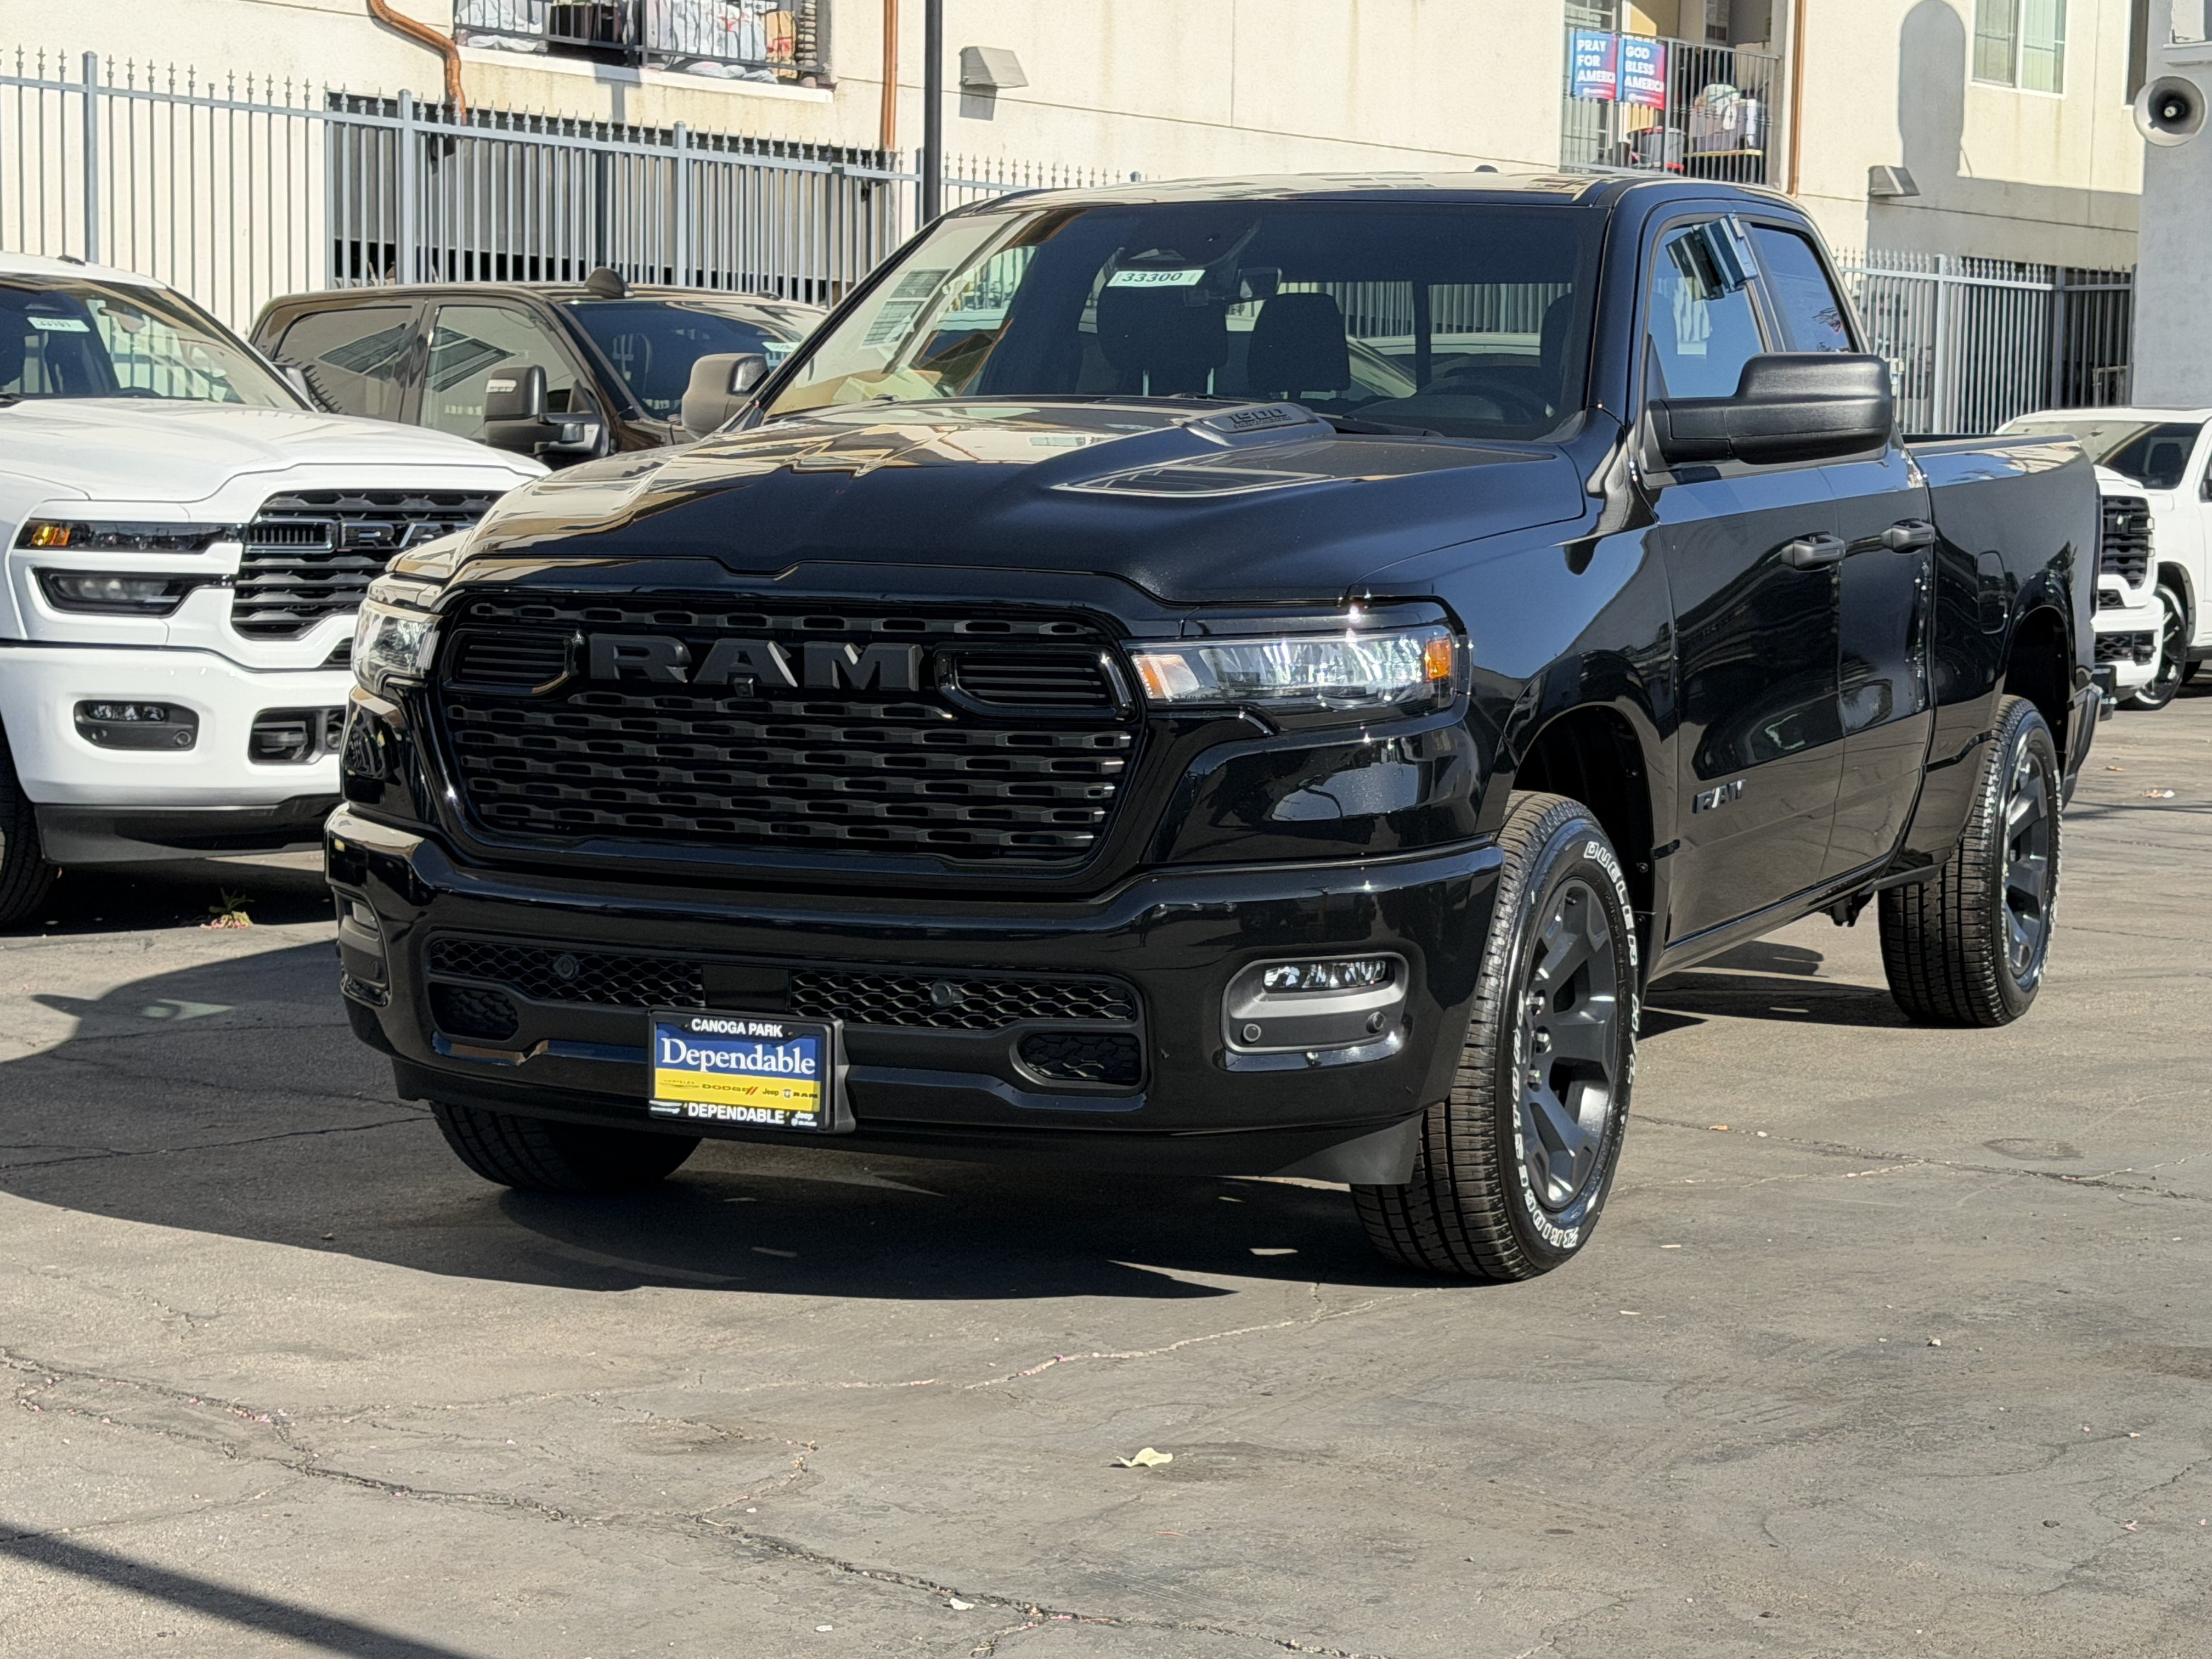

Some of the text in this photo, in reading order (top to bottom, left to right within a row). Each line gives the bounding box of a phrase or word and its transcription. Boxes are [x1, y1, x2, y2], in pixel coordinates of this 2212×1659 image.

[1577, 40, 1607, 52] PRAY
[1625, 46, 1651, 59] GOD
[1577, 55, 1601, 67] FOR
[1624, 60, 1655, 76] BLESS
[1577, 70, 1616, 84] AMERIC
[1624, 75, 1664, 93] AMERIC
[1121, 272, 1183, 283] 33300
[1227, 408, 1288, 424] 1500
[340, 520, 476, 549] RA
[588, 633, 923, 692] RAM
[1583, 840, 1638, 966] DUELER
[691, 1018, 783, 1038] CANOGA PARK
[661, 1037, 815, 1074] Dependable
[688, 1102, 785, 1125] DEPENDABLE
[1510, 989, 1578, 1249] BRIDGESTONE
